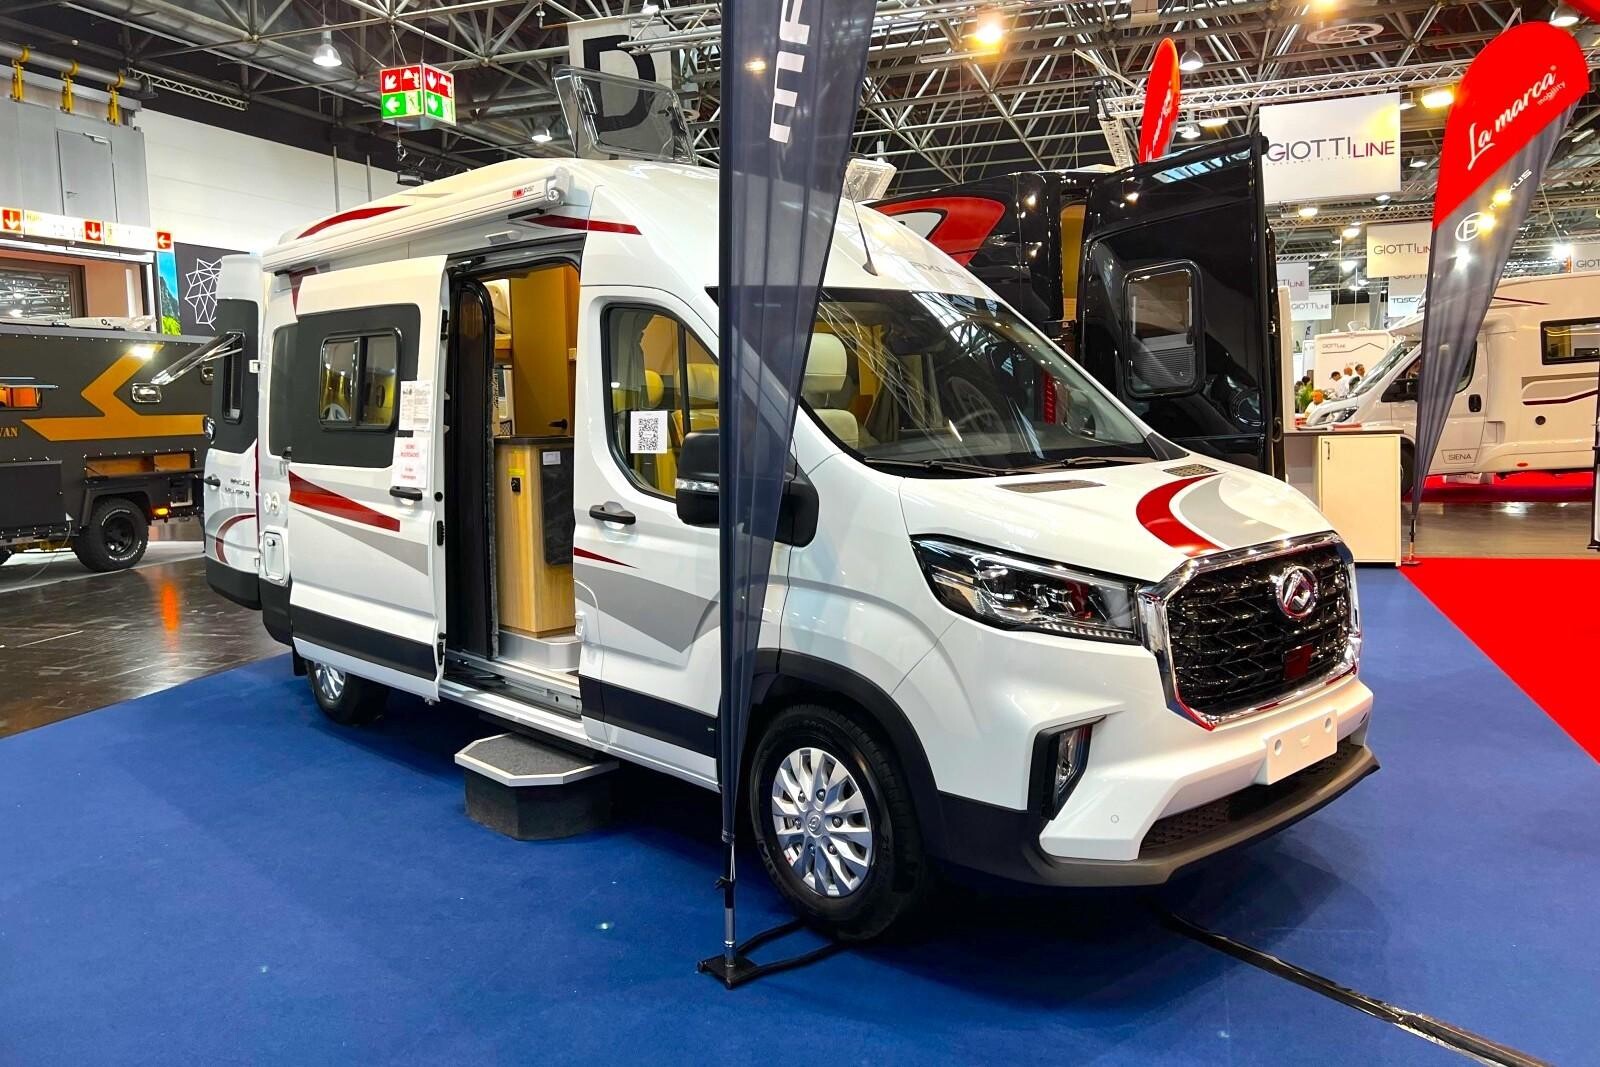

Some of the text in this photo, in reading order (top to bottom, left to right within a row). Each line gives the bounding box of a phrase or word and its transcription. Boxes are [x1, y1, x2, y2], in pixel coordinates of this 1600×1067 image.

[583, 34, 656, 132] D
[1537, 81, 1566, 106] mobility
[1467, 72, 1557, 171] La marca
[1266, 136, 1395, 162] GIOTTILINE
[1448, 453, 1472, 461] SIENA
